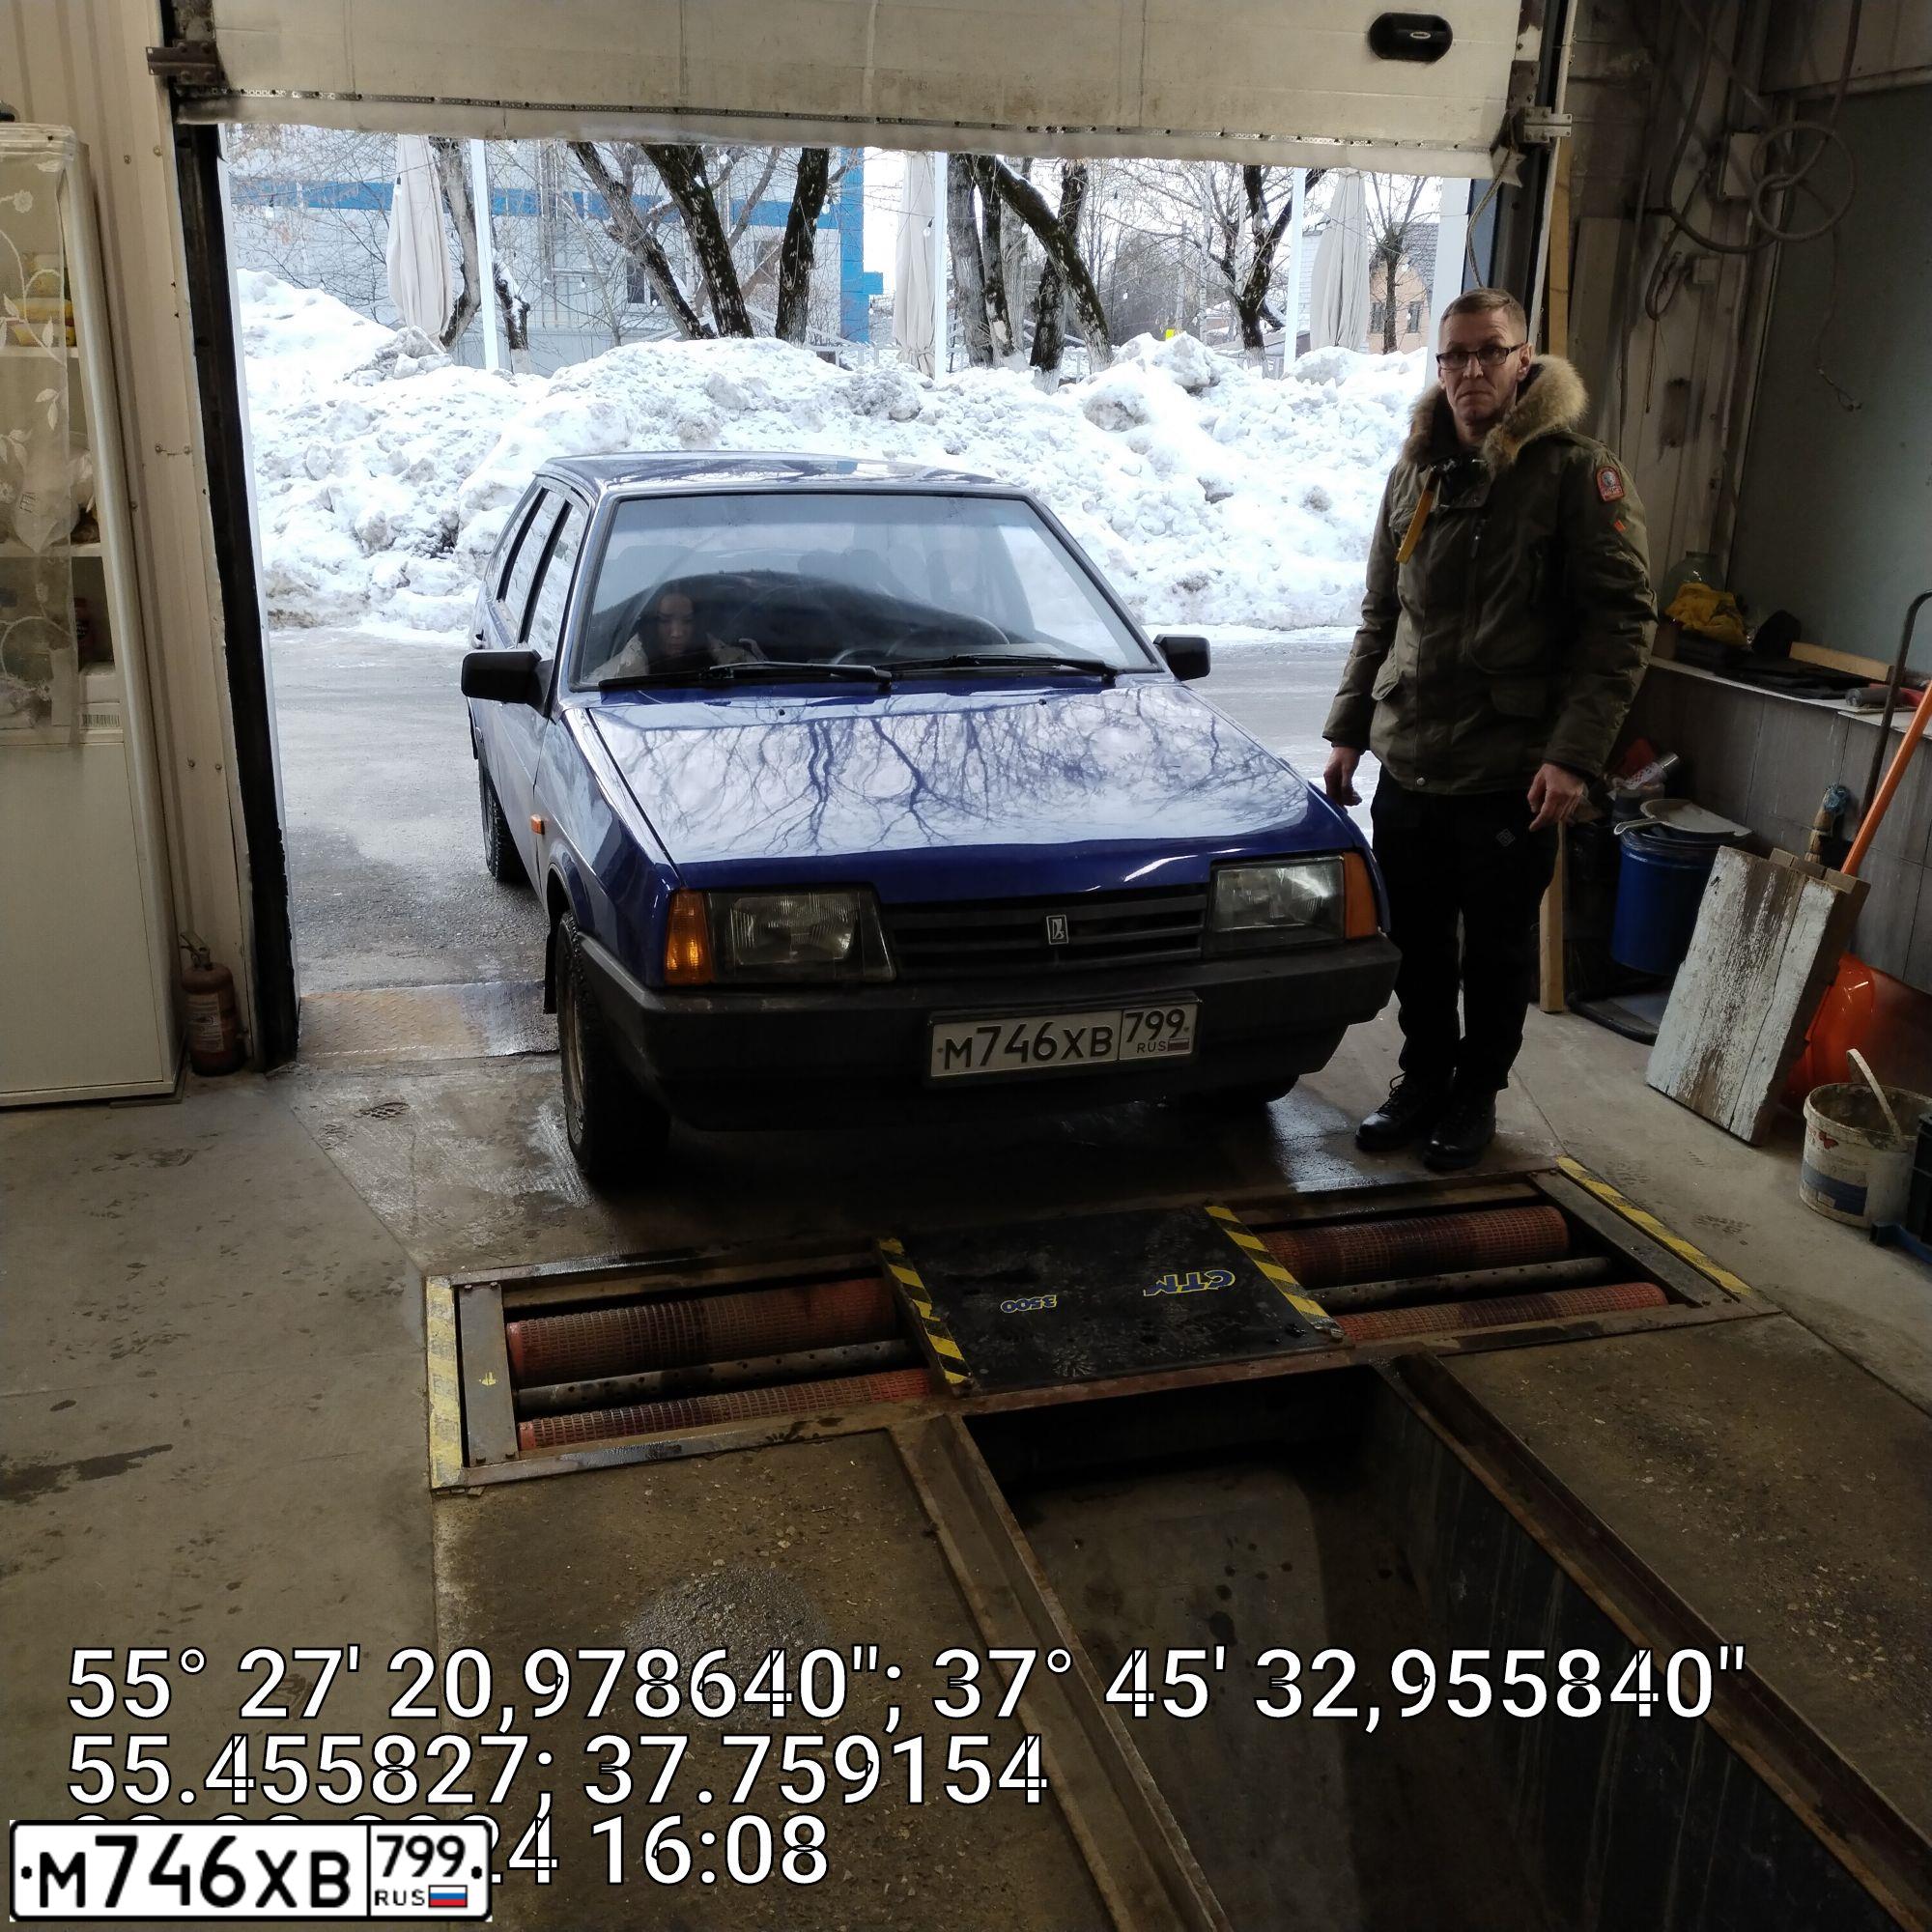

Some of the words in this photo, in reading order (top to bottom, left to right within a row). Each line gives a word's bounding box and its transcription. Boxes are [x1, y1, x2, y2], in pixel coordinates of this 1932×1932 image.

[944, 1021, 1113, 1070] М746ХВ
[1125, 1009, 1186, 1043] 799
[1137, 1040, 1166, 1054] RUS
[1000, 1294, 1057, 1314] 3500
